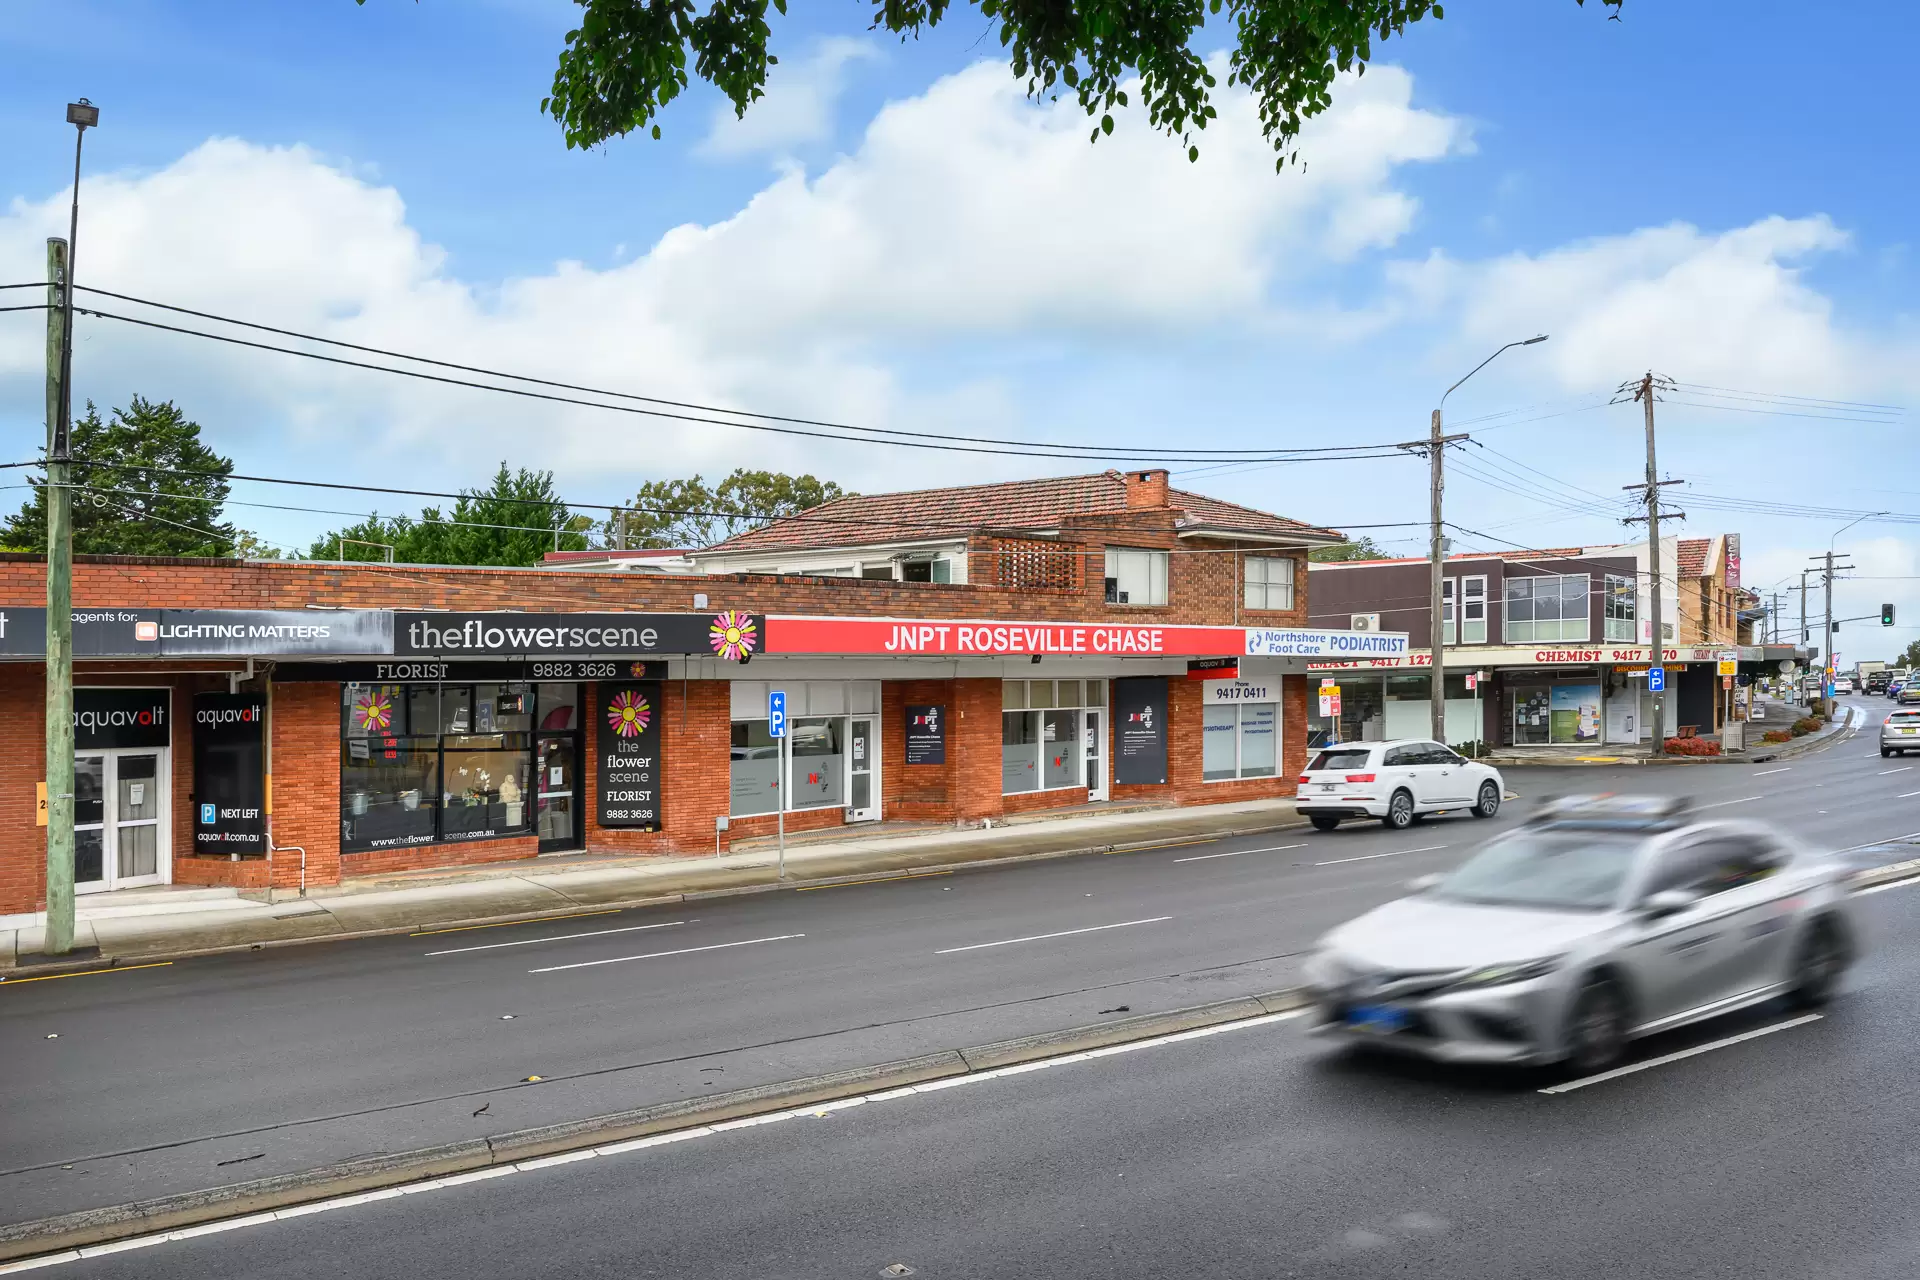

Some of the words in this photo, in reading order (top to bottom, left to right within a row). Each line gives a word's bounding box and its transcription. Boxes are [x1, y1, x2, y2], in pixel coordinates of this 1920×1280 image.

[71, 611, 115, 624] agents
[118, 611, 139, 622] for:
[159, 624, 245, 638] LIGHTING
[248, 624, 331, 639] MATTERS
[408, 619, 659, 649] theflowerscene
[1265, 631, 1326, 643] Northshore
[884, 626, 950, 651] JNPT
[957, 628, 1086, 652] ROSEVILLE
[1092, 629, 1164, 652] CHASE
[1330, 636, 1405, 652] PODIATRIST
[1269, 643, 1293, 653] Foot
[1296, 643, 1321, 654] Care
[1408, 654, 1433, 665] 127
[1535, 650, 1602, 662] CHEMIST
[1612, 650, 1642, 661] 9417
[1647, 650, 1677, 661] 170
[376, 663, 449, 679] FLORIST
[533, 663, 573, 678] 9882
[577, 662, 617, 677] 3626
[1216, 687, 1241, 699] 9417
[1243, 687, 1267, 698] 0411
[196, 704, 261, 729] aquavolt
[772, 711, 784, 732] P
[617, 739, 639, 753] the
[606, 754, 652, 768] flower
[609, 772, 649, 783] scene
[606, 790, 652, 802] FLORIST
[204, 806, 213, 822] P
[221, 808, 241, 819] NEXT
[242, 808, 259, 819] LEFT
[606, 809, 629, 819] 9882
[630, 809, 653, 819] 3626
[197, 831, 260, 843] aquavolt.com.au
